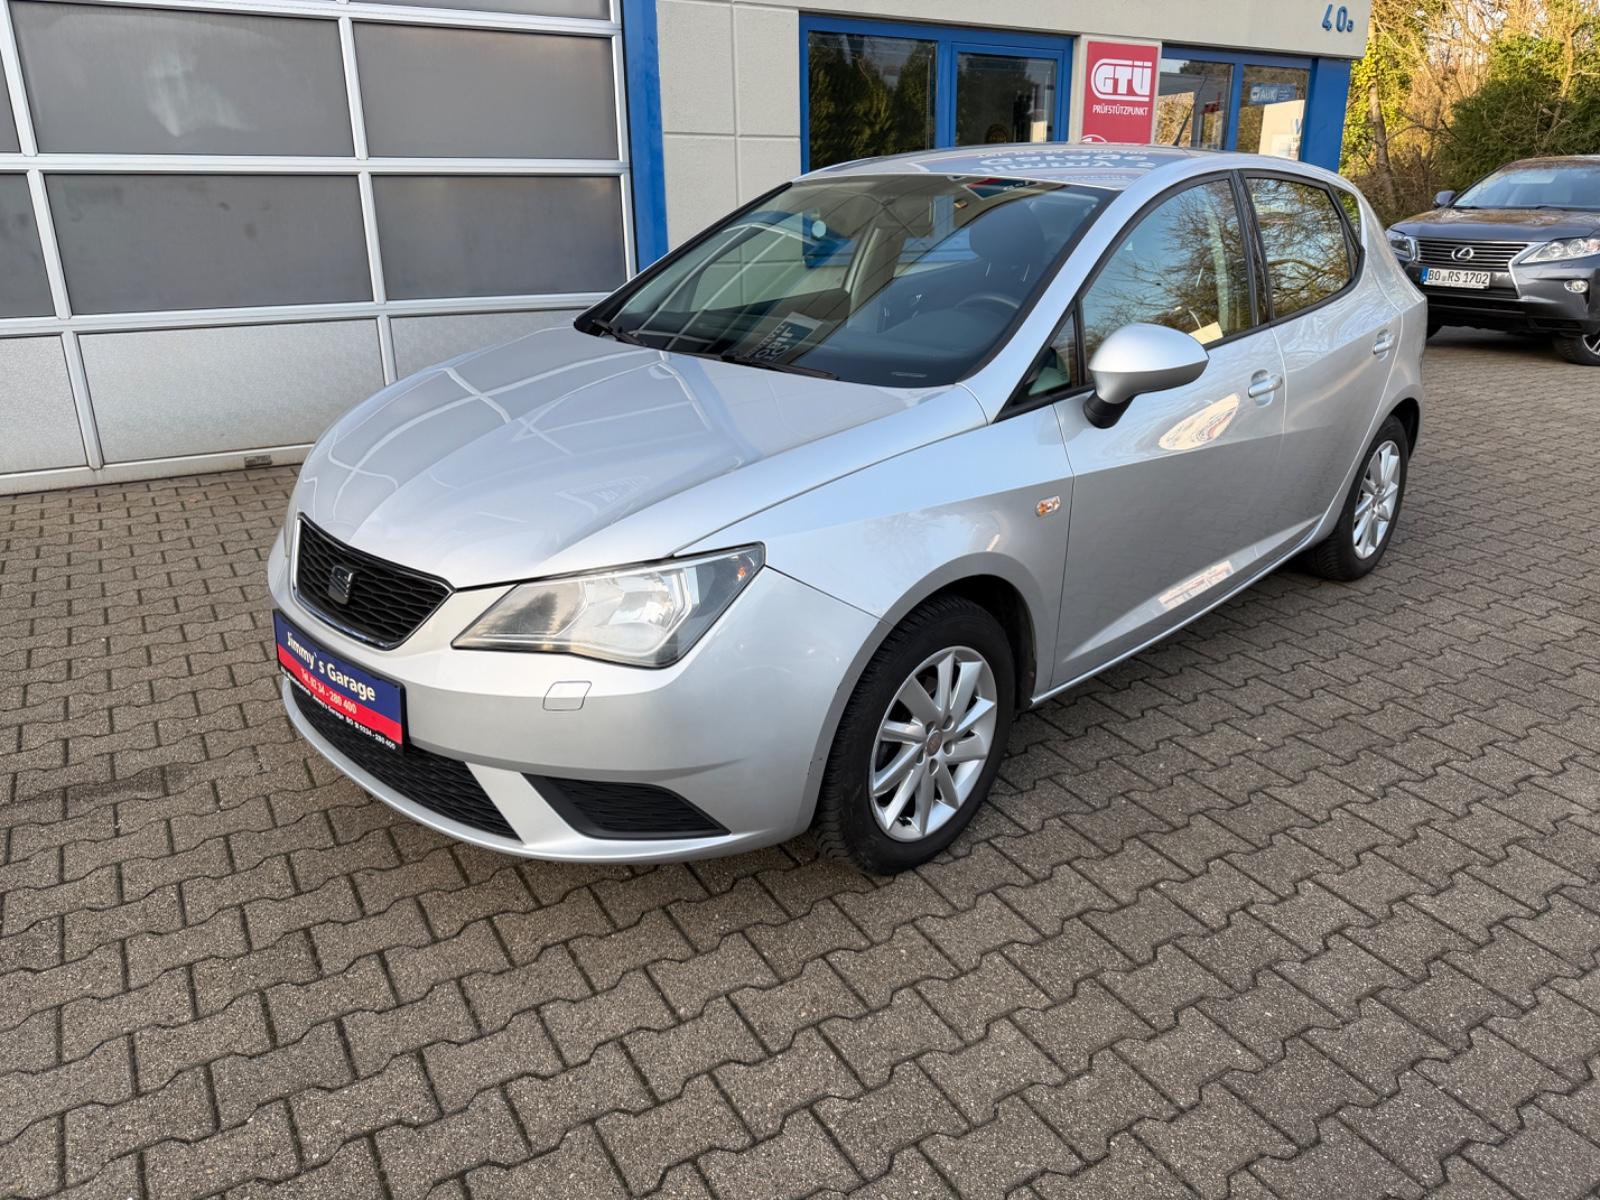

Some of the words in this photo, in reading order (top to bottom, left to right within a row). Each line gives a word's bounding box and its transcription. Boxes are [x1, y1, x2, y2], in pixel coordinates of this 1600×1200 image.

[1093, 60, 1152, 97] GTÜ
[1092, 103, 1149, 117] PRÜFSTÜTZPUNKT
[1428, 269, 1441, 281] BO
[1448, 271, 1461, 282] RS
[1462, 272, 1489, 285] 1702
[327, 662, 376, 701] Garage
[343, 699, 357, 714] 400
